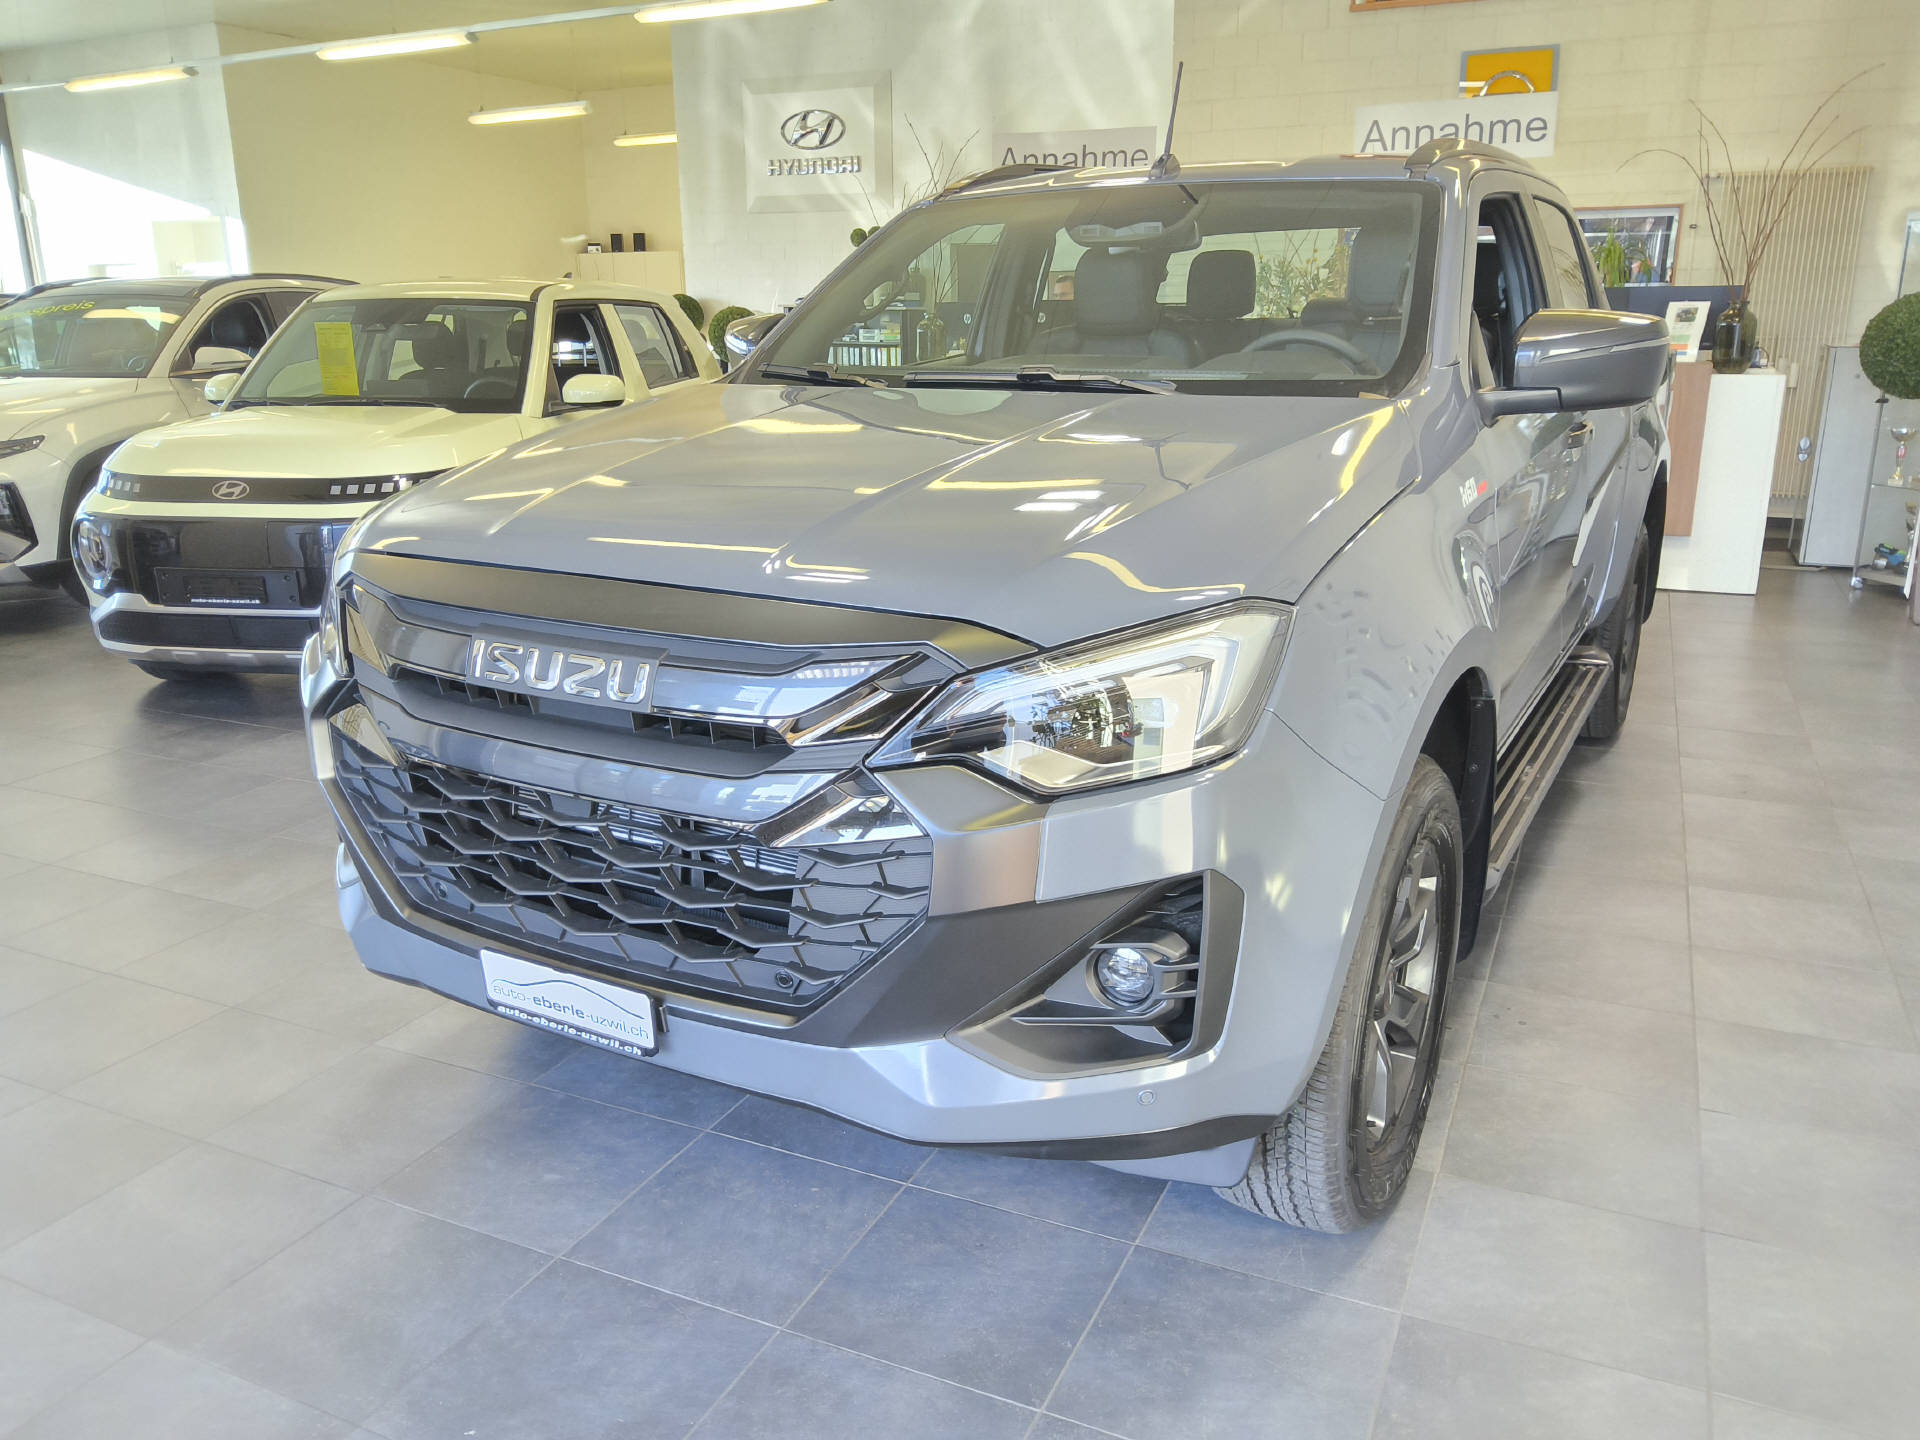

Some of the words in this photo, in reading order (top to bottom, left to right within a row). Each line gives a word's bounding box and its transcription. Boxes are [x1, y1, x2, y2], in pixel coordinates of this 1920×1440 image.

[1360, 113, 1549, 153] Annahme
[767, 156, 861, 176] HYUNDAI
[470, 639, 650, 704] ISUZU
[493, 984, 649, 1040] auto-eberle-uzwil.ch
[497, 1005, 642, 1056] auto-eberle-uzwil.ch
